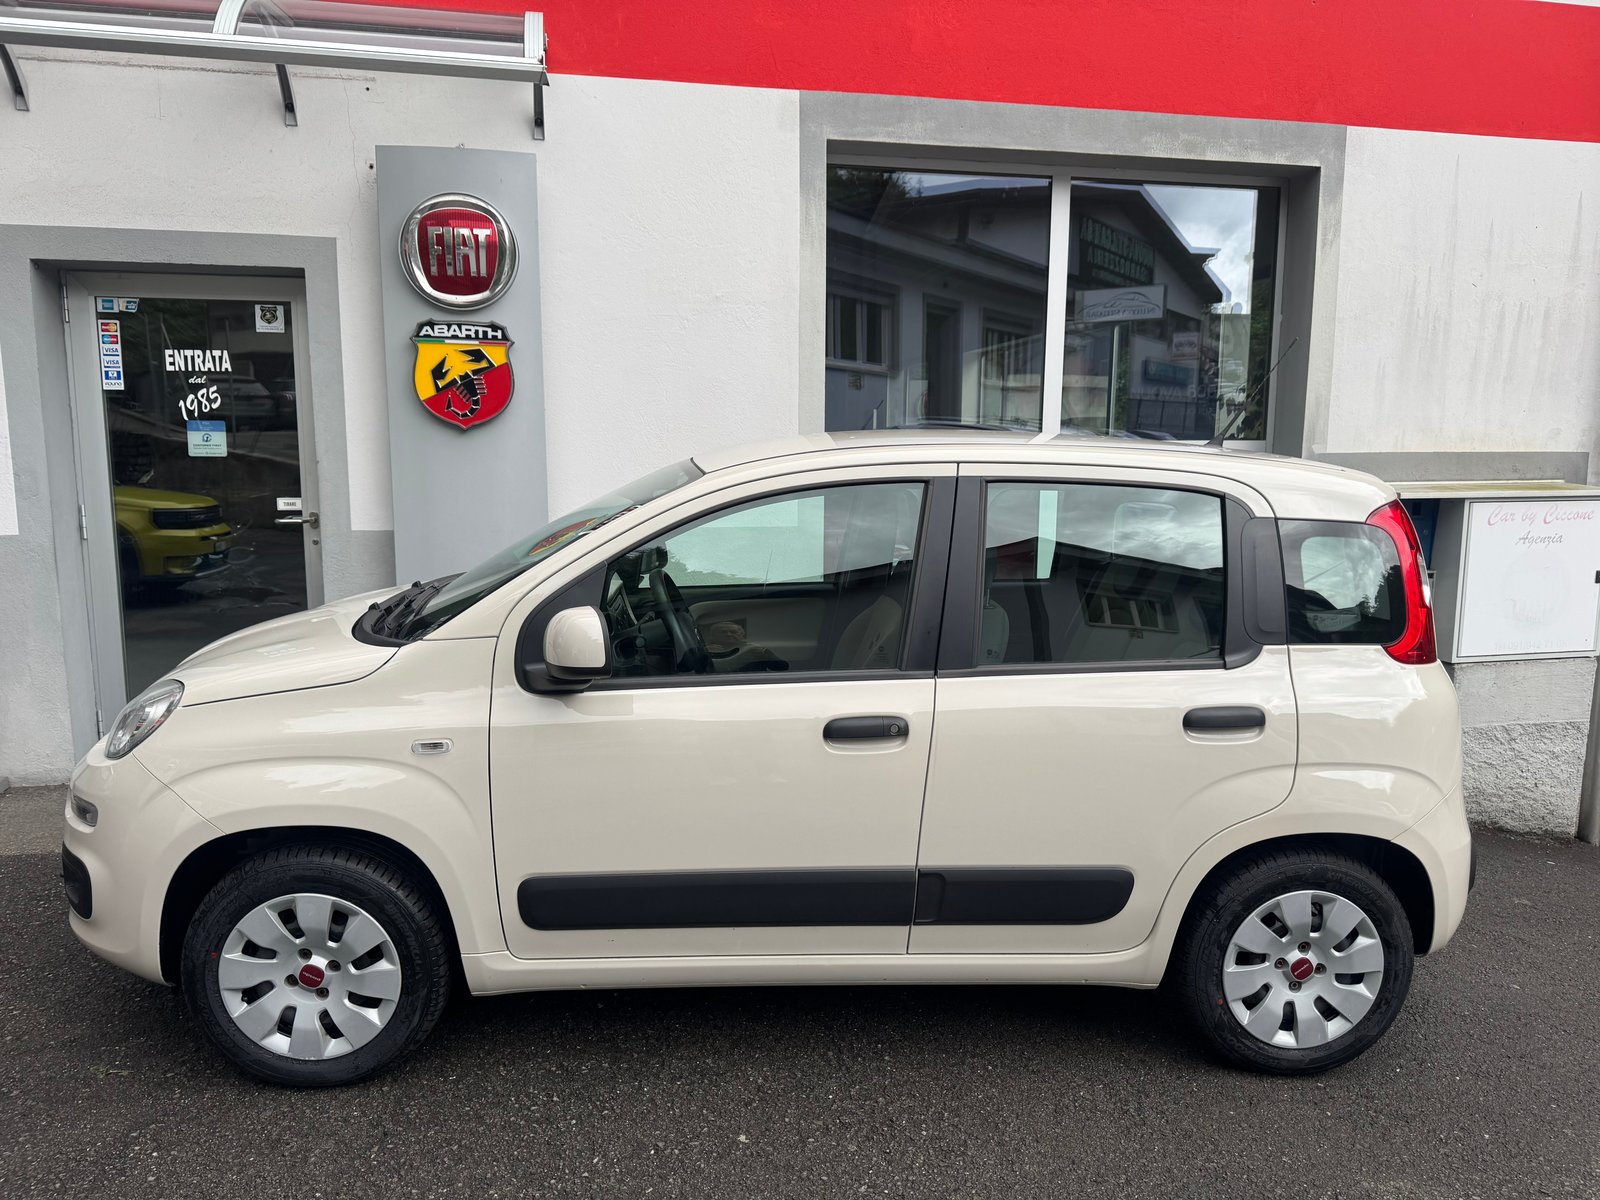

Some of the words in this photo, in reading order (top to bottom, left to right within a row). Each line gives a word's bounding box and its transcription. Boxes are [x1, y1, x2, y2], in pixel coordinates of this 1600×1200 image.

[426, 225, 492, 278] FIAT
[419, 324, 503, 340] ABARTH
[164, 349, 232, 372] ENTRATA
[188, 375, 207, 384] dal
[178, 385, 222, 421] 1985
[1487, 505, 1515, 526] Car
[1521, 507, 1537, 526] by
[1543, 503, 1595, 525] Ciccone
[1515, 530, 1564, 549] Agenzia
